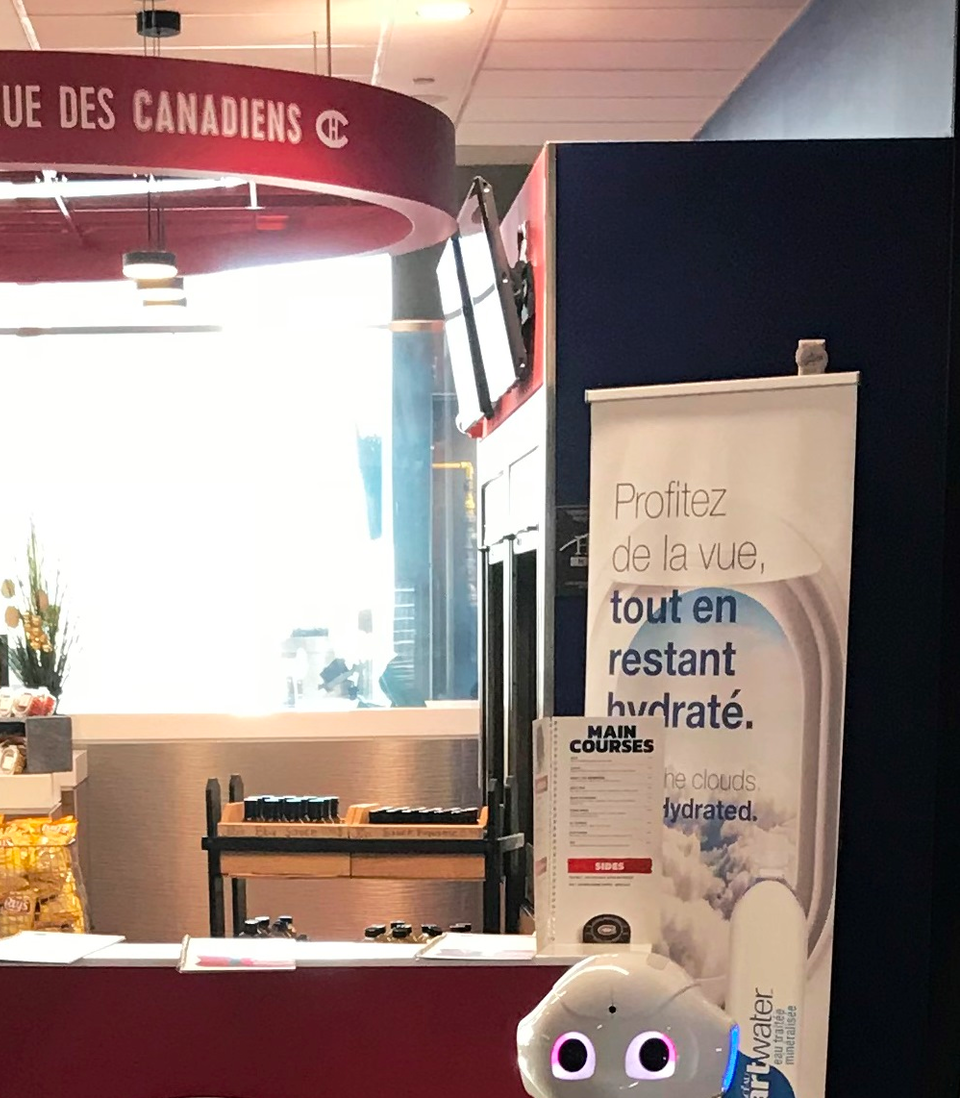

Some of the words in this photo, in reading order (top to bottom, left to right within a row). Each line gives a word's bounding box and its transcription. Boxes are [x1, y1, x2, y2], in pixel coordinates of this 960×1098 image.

[59, 85, 116, 130] DES
[132, 88, 302, 145] CANADIENS
[614, 480, 727, 520] Profitez
[611, 535, 651, 573] de
[662, 534, 687, 573] la
[697, 539, 765, 575] vue,
[610, 589, 683, 624] tout
[692, 592, 737, 624] en
[608, 641, 736, 677] restant
[569, 738, 654, 754] COURSES
[587, 724, 637, 739] MAIN
[692, 768, 761, 792] clouds.
[594, 862, 625, 871] SIDES
[773, 1048, 784, 1066] eau
